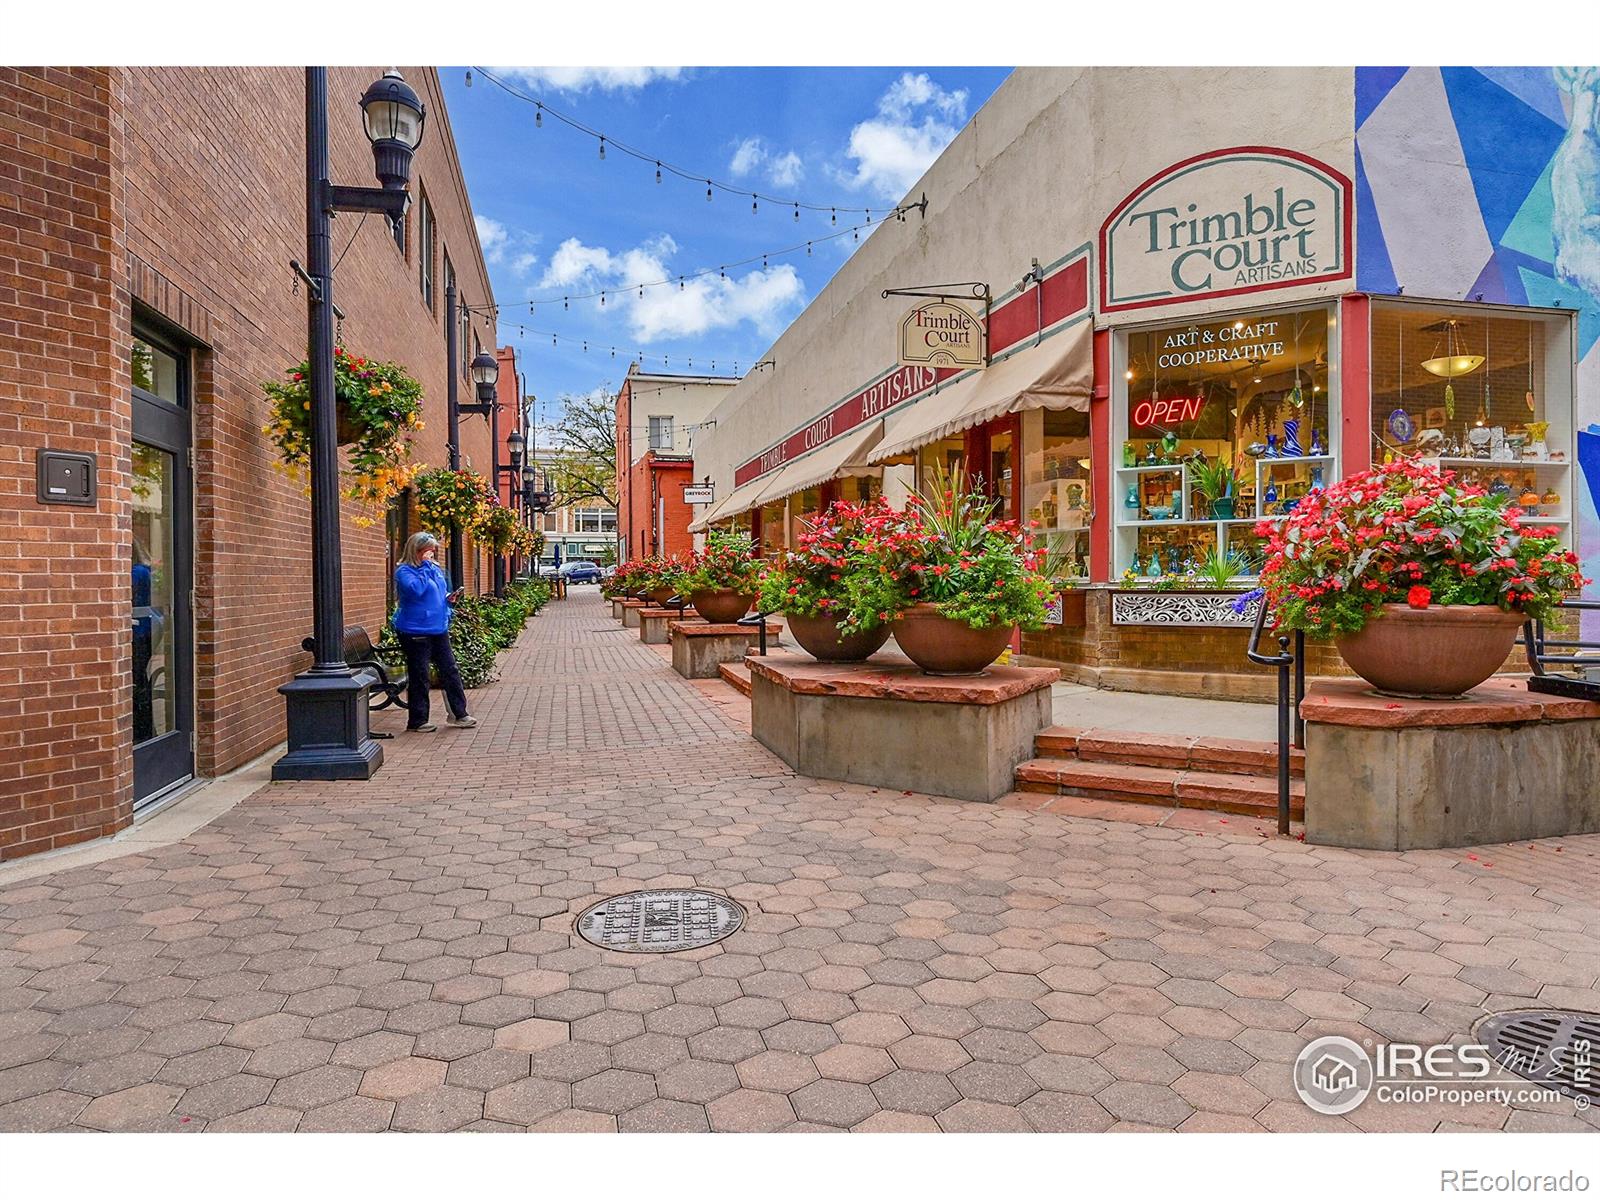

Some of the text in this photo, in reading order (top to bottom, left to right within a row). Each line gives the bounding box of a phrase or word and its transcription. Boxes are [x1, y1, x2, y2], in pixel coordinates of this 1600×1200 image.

[1129, 187, 1316, 253] Trimble
[1171, 228, 1316, 292] Court
[1234, 258, 1318, 286] ARTISANS
[912, 309, 971, 330] Trimble
[924, 330, 970, 348] Court
[1164, 321, 1279, 349] ART & CRAFT
[1158, 341, 1285, 369] COOPERATIVE
[804, 413, 835, 450] COURT
[860, 366, 936, 421] ARTISANS
[1134, 397, 1201, 426] OPEN
